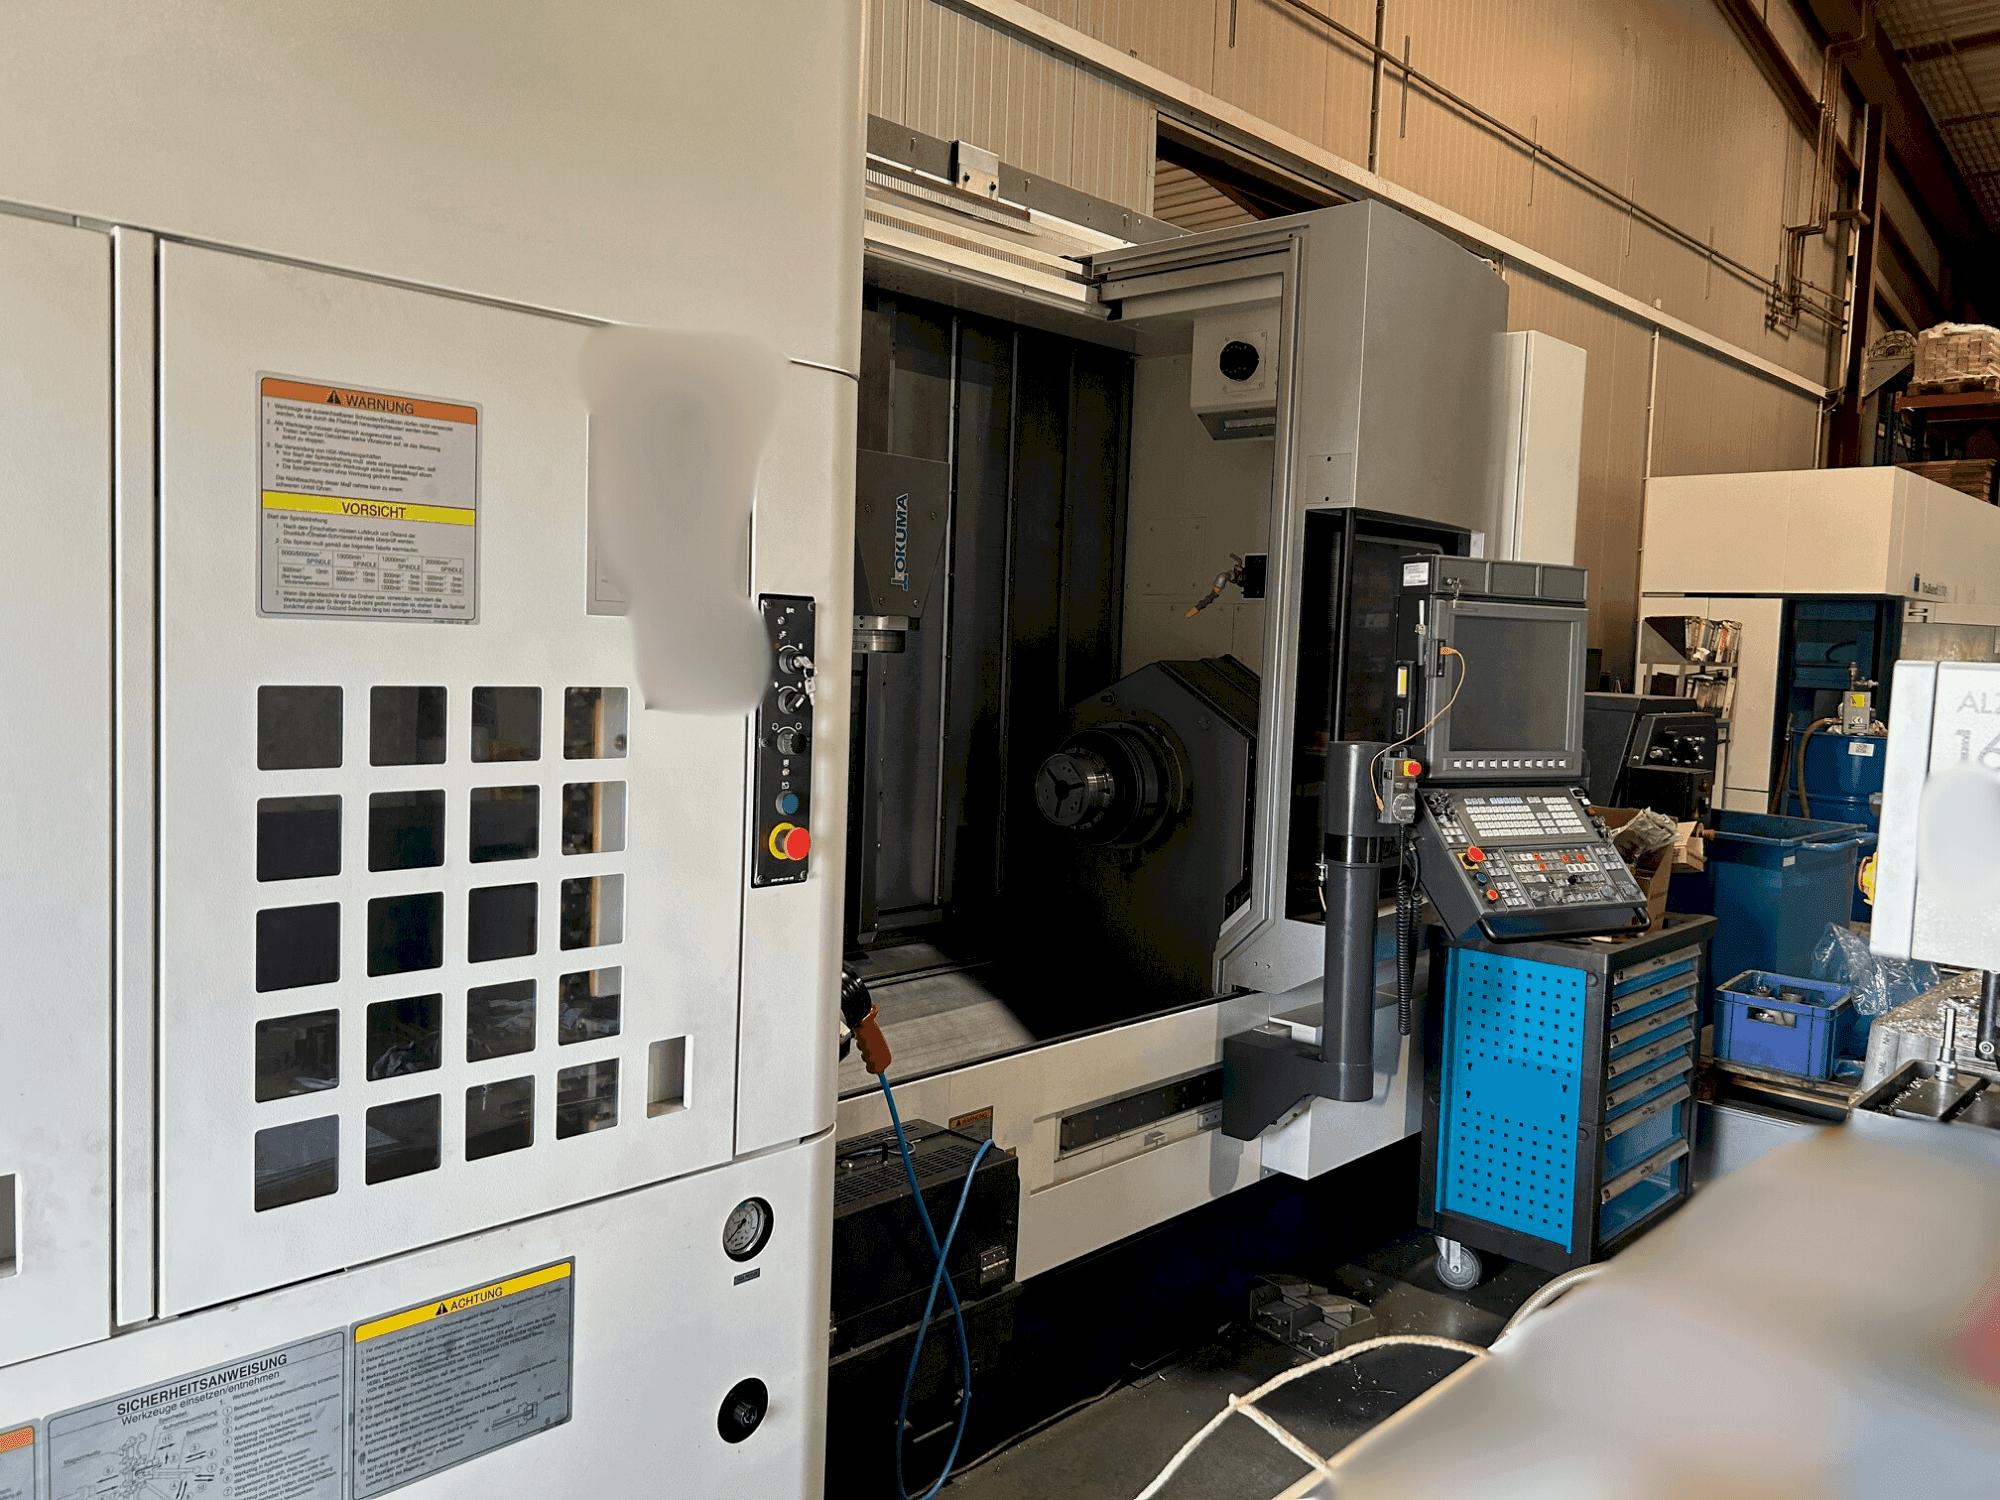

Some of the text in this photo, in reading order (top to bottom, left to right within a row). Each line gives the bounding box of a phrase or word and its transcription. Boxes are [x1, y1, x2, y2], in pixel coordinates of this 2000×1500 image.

[345, 394, 413, 414] WARNUNG
[341, 501, 406, 518] VORSICHT
[895, 492, 909, 574] OKUMA
[450, 1285, 502, 1311] ACHTUNG
[117, 1353, 287, 1416] SICHERHEITSANWEISUNG
[121, 1369, 279, 1427] Werkzeuge einsetzen/entnehmen
